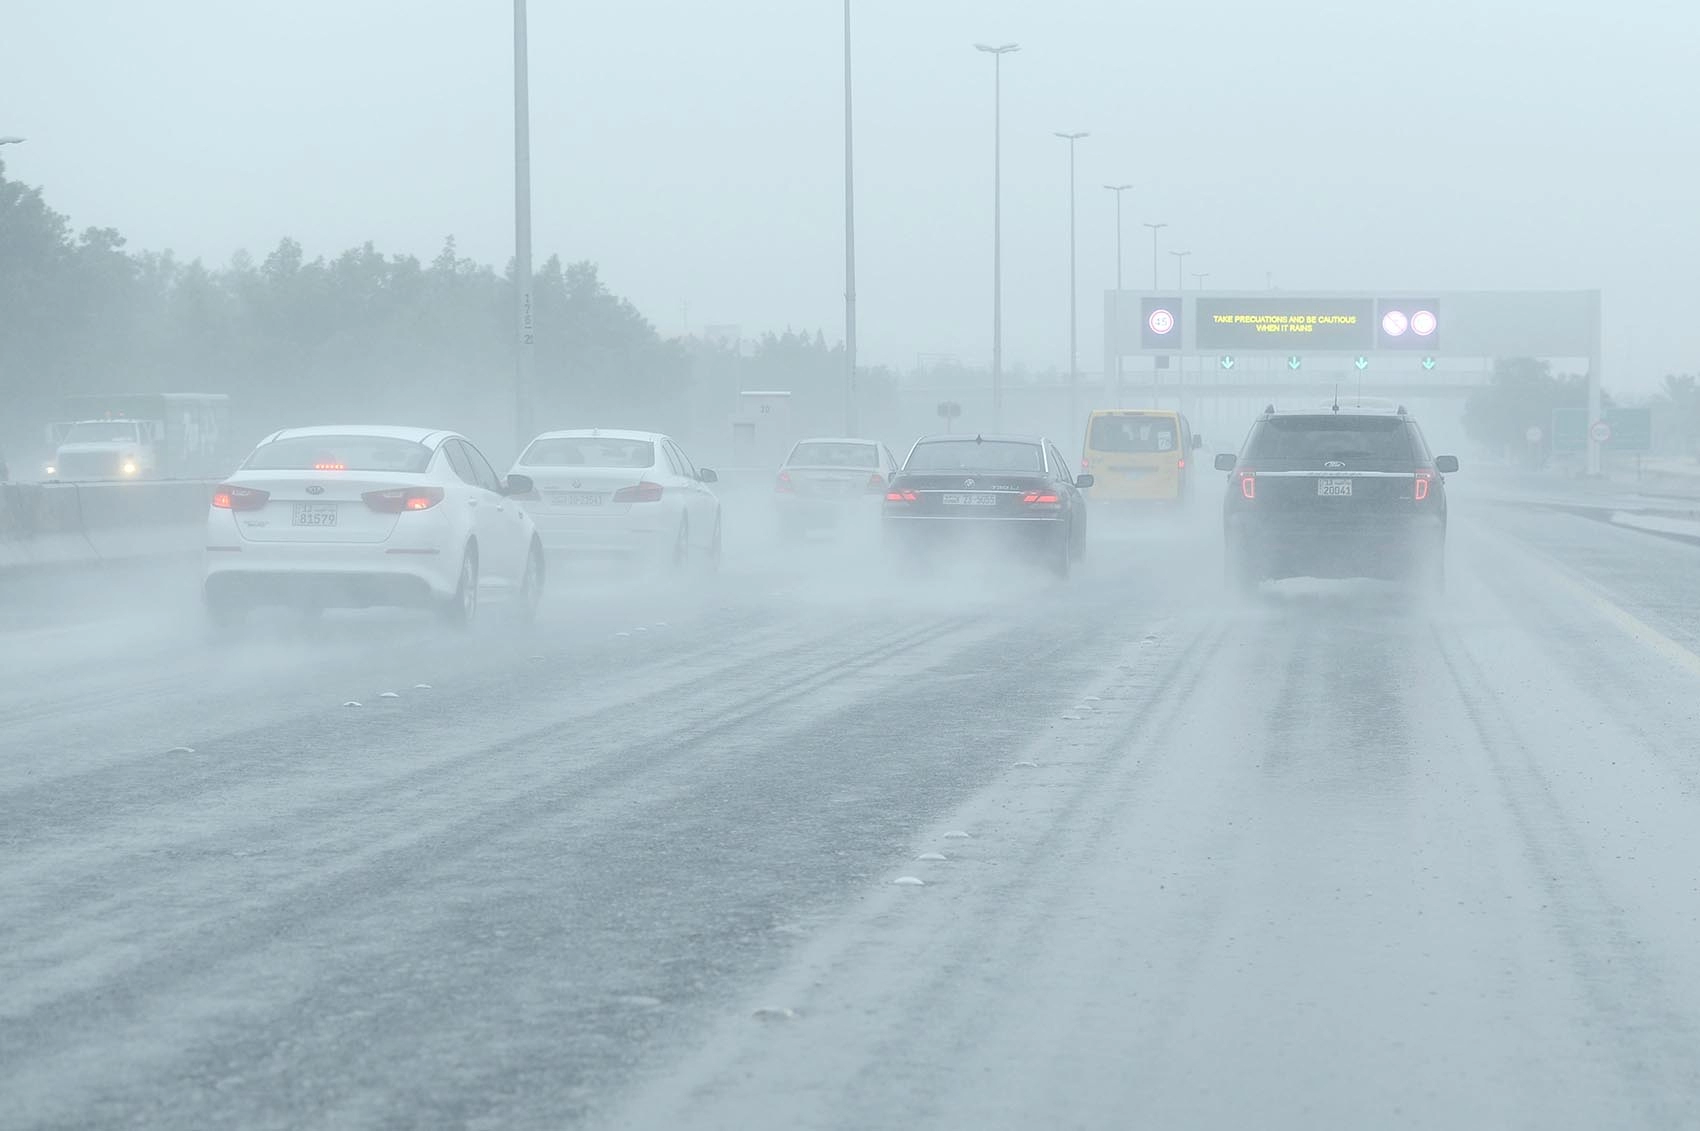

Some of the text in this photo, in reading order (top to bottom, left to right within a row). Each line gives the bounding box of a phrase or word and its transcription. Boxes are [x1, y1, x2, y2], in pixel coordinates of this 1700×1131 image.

[1213, 315, 1233, 323] TAKE
[1288, 315, 1305, 324] AND
[1306, 315, 1317, 324] BE
[1318, 315, 1357, 324] CAUTIOUS
[1255, 324, 1313, 332] WHEN IT RAINS
[1323, 486, 1351, 495] 20041
[300, 513, 335, 524] 81579
